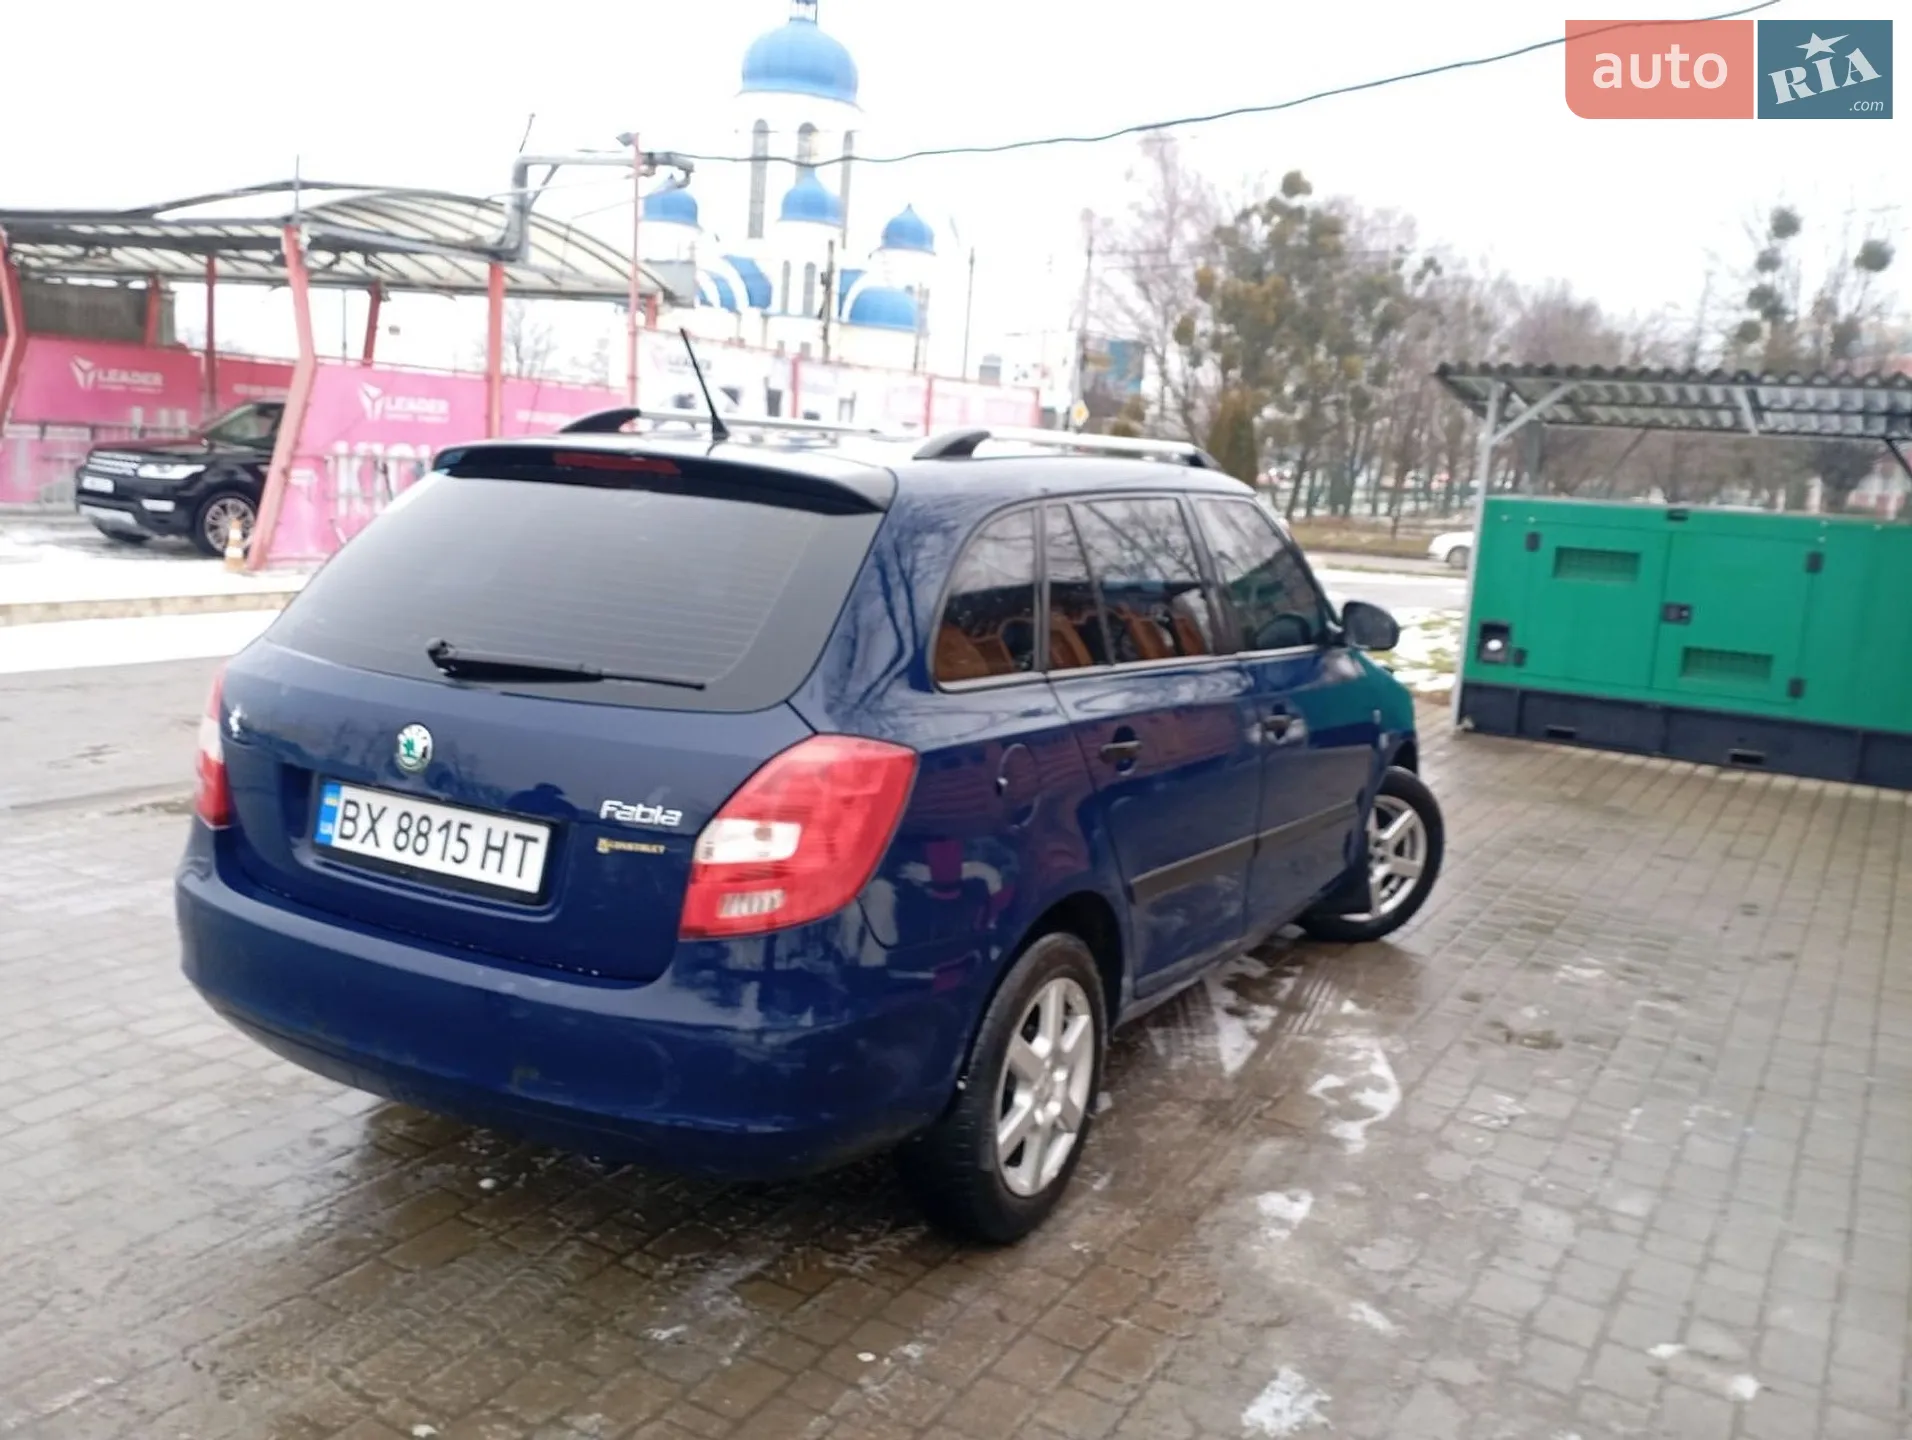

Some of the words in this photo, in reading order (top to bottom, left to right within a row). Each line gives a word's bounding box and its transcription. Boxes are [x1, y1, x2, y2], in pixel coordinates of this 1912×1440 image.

[339, 799, 388, 848] BX
[394, 811, 472, 864] 8815
[480, 827, 539, 878] HT
[600, 799, 683, 828] Fabia
